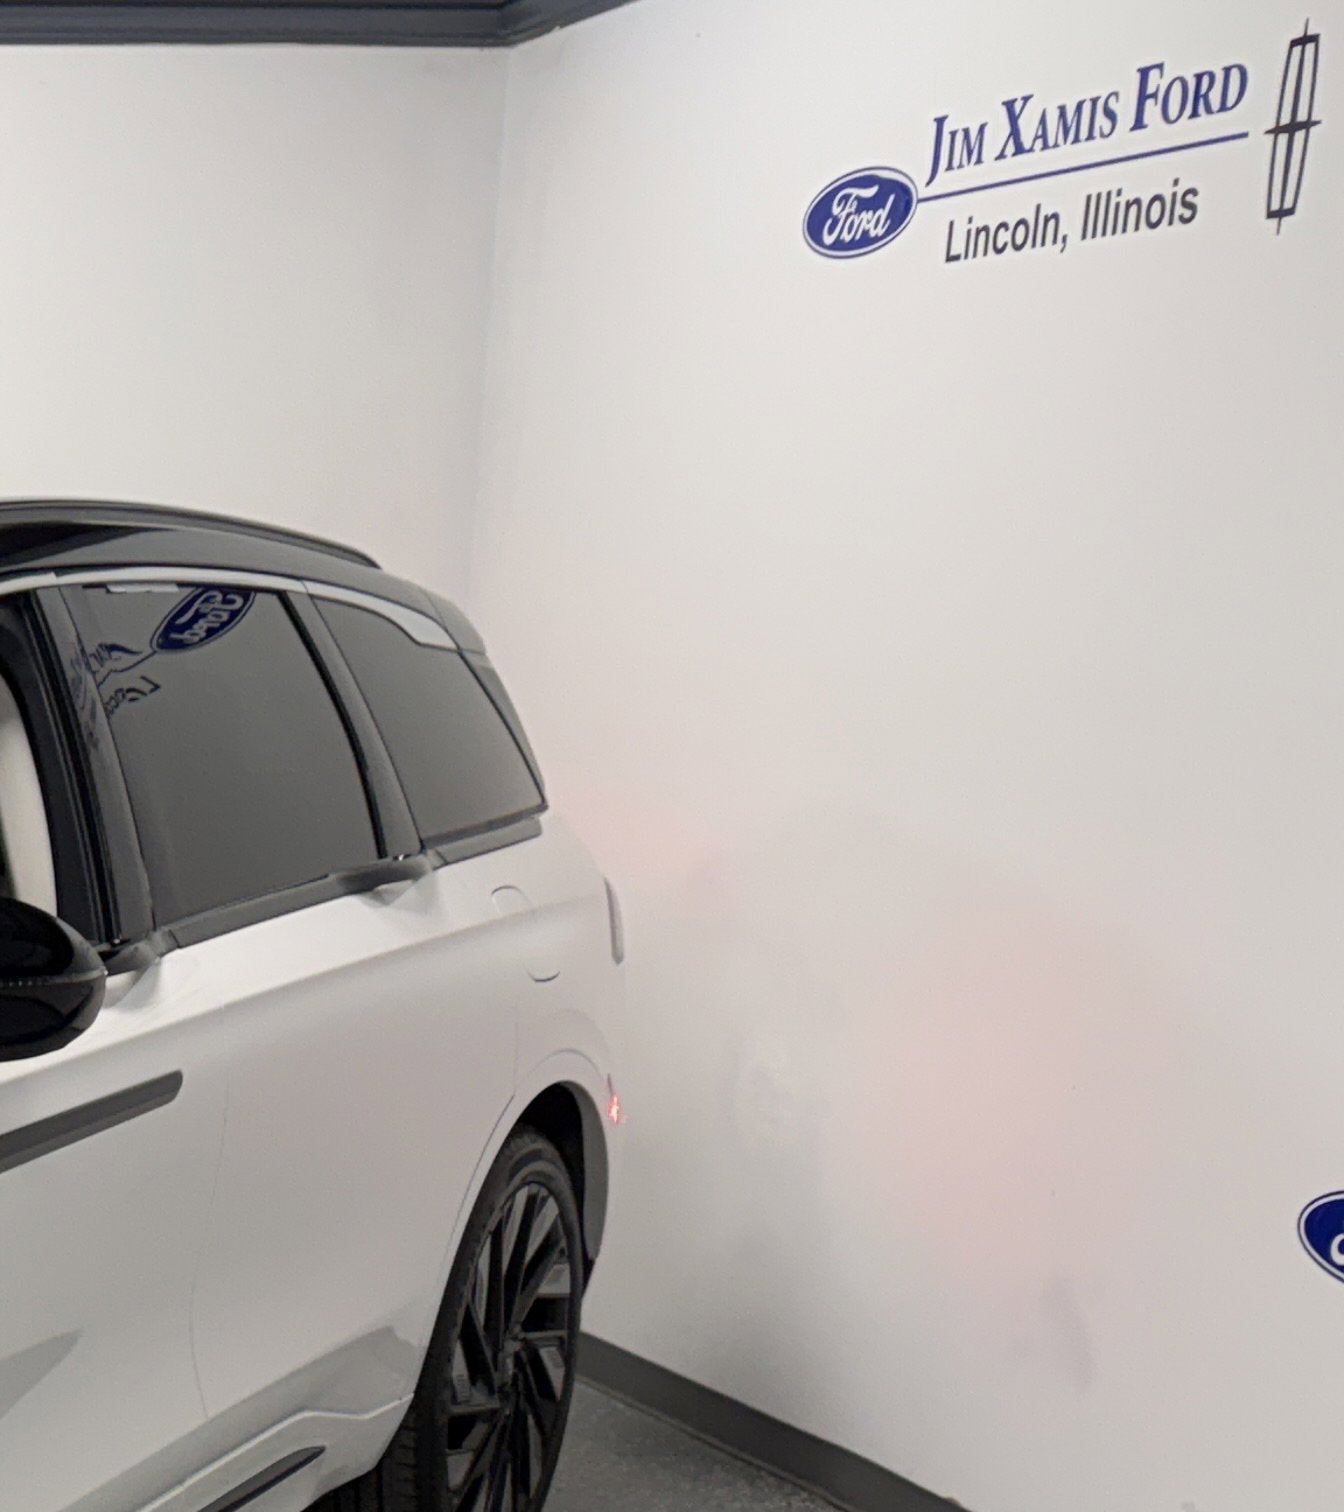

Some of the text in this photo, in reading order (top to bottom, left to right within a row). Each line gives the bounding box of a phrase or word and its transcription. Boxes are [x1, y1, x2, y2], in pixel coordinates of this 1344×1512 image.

[925, 61, 1249, 188] JIM XAMIS FORD
[822, 185, 896, 246] Ford
[944, 177, 1201, 264] Lincoln, Illinois
